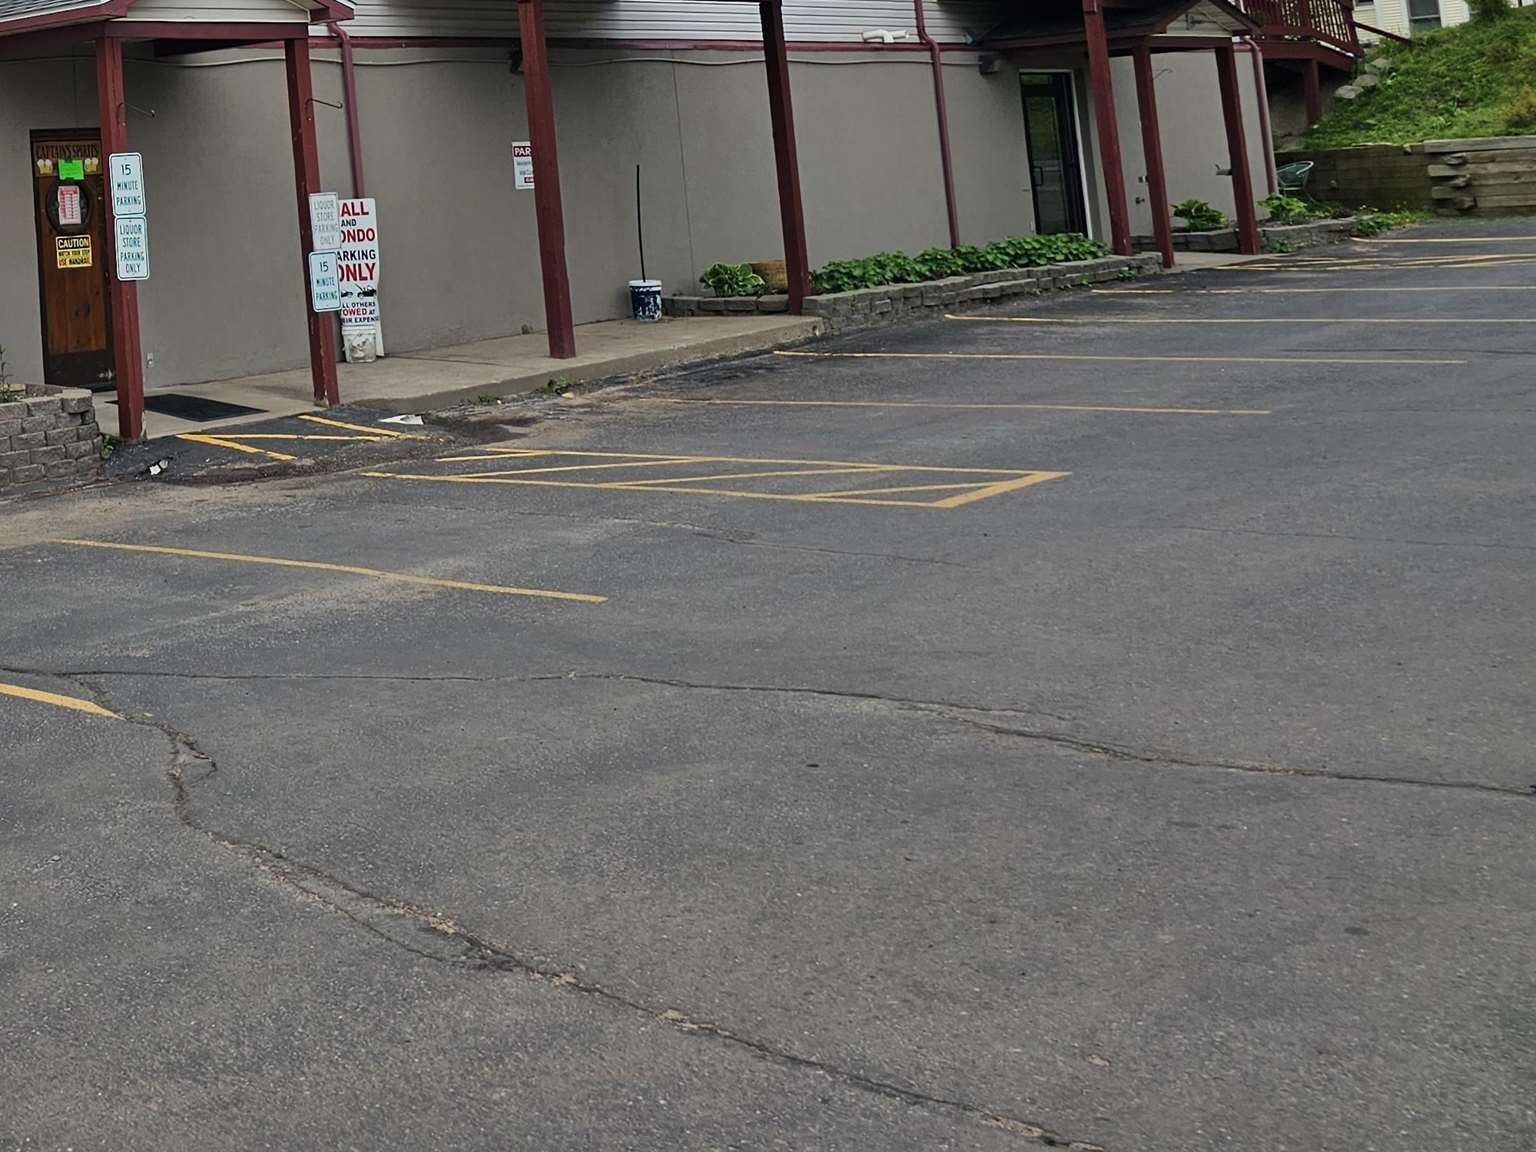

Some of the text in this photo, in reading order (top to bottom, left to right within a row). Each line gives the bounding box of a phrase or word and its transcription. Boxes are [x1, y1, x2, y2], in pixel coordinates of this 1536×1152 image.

[121, 164, 132, 176] 15
[117, 180, 138, 191] MINUTE
[116, 196, 141, 206] PARKING
[341, 219, 356, 227] AND
[120, 224, 143, 235] LIQUOR
[58, 238, 89, 249] CAUTION
[122, 238, 140, 248] STORE
[120, 251, 145, 262] PARKING
[336, 249, 376, 261] ARKING
[125, 263, 141, 273] ONLY
[319, 261, 329, 272] 15
[316, 277, 335, 286] MINUTE
[315, 291, 337, 301] PARKING
